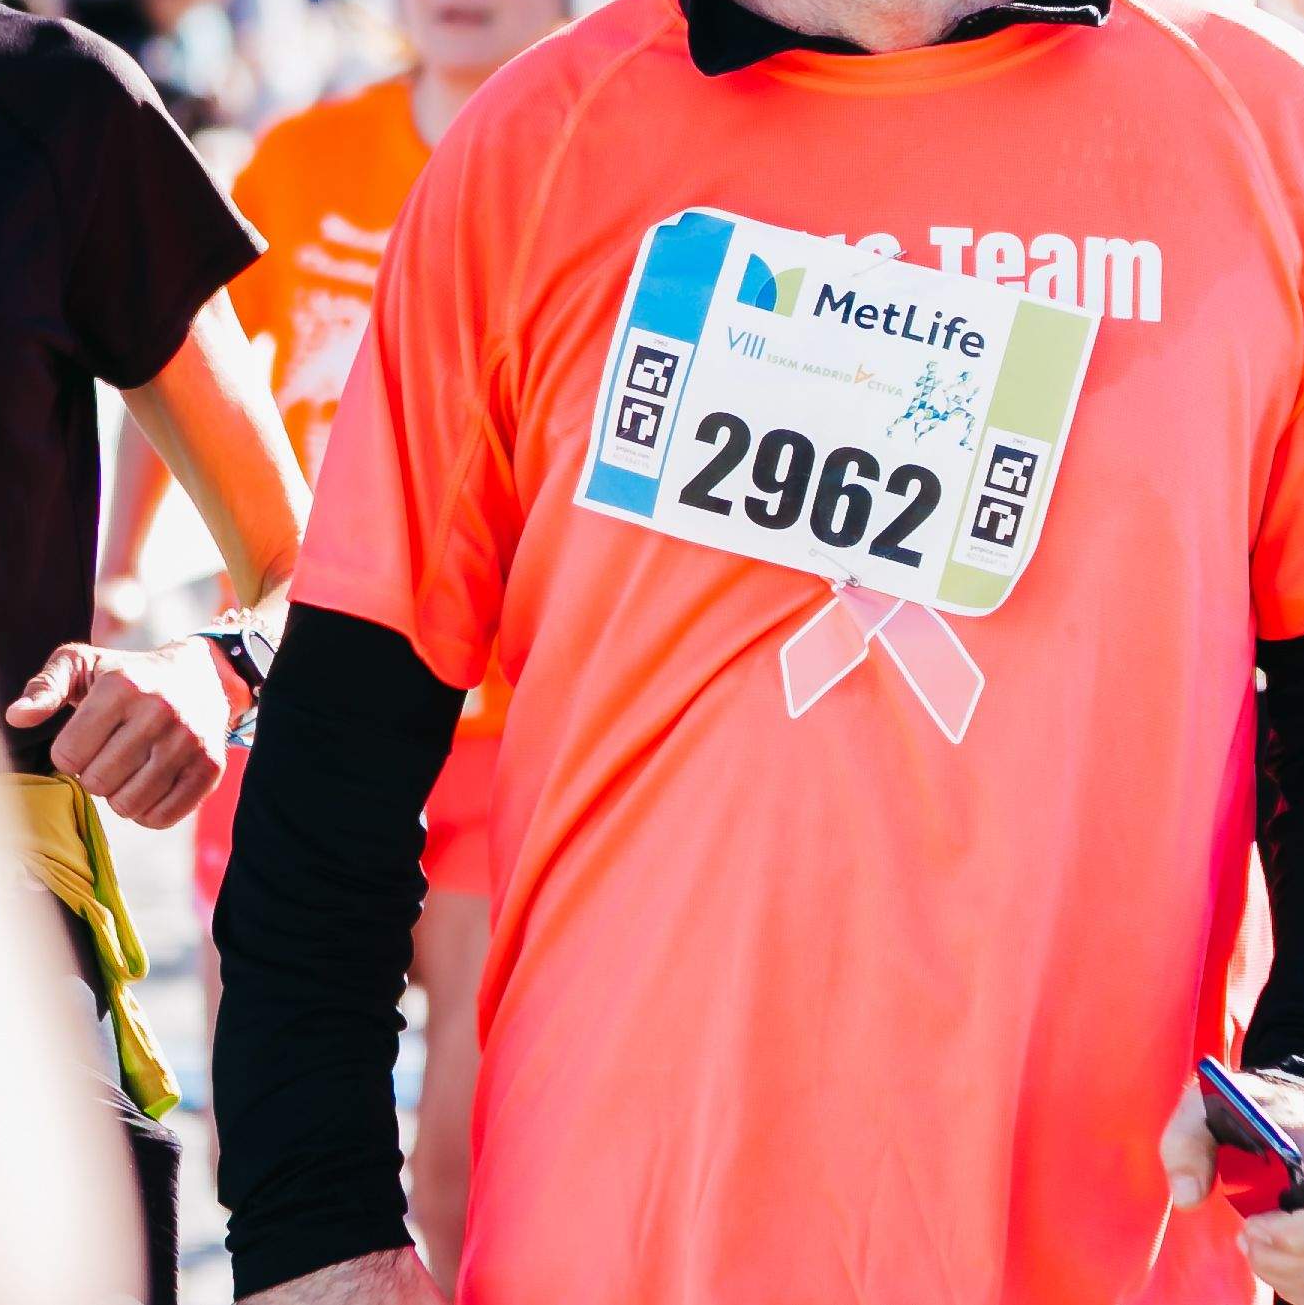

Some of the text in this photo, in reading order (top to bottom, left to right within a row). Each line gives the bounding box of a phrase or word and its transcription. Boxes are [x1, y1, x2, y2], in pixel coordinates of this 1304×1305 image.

[727, 326, 767, 360] VIII
[802, 362, 853, 384] MADRID
[812, 283, 985, 358] MetLife
[678, 411, 942, 569] 2962
